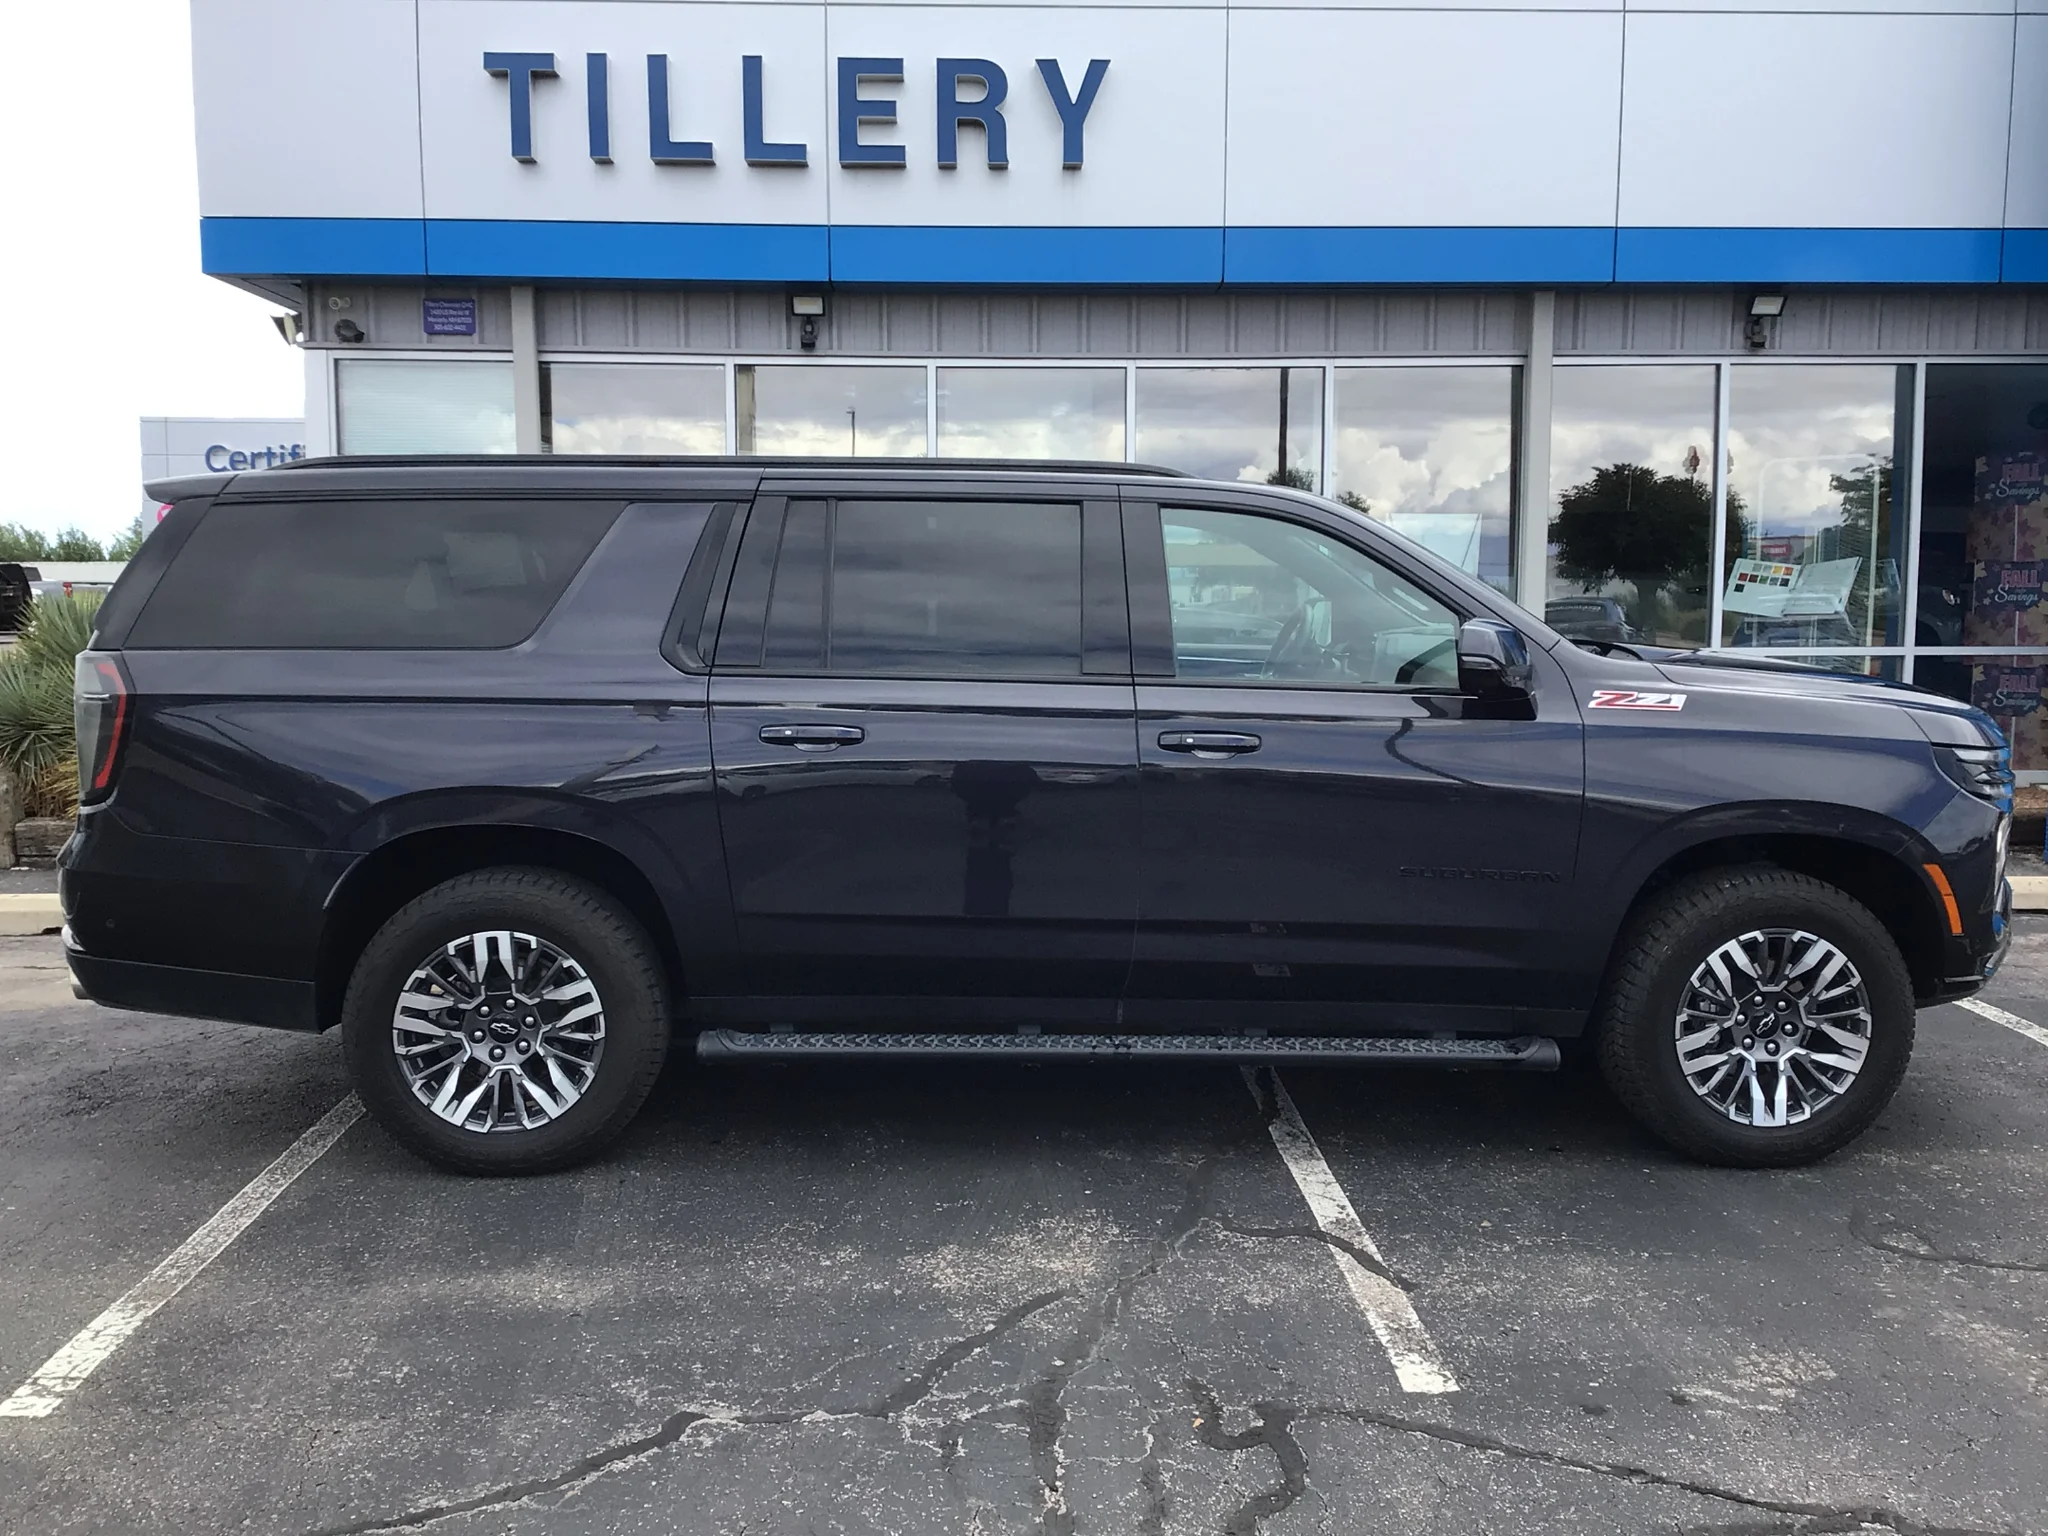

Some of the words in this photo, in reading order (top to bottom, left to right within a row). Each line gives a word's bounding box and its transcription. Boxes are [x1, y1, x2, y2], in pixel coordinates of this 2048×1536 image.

[483, 51, 1111, 169] TILLERY
[204, 444, 306, 473] Certif
[1996, 478, 2041, 500] Savings
[2001, 570, 2040, 588] FALL
[1994, 583, 2039, 606] Savings
[1588, 690, 1687, 711] Z71
[1400, 866, 1561, 884] SUBURBAN
